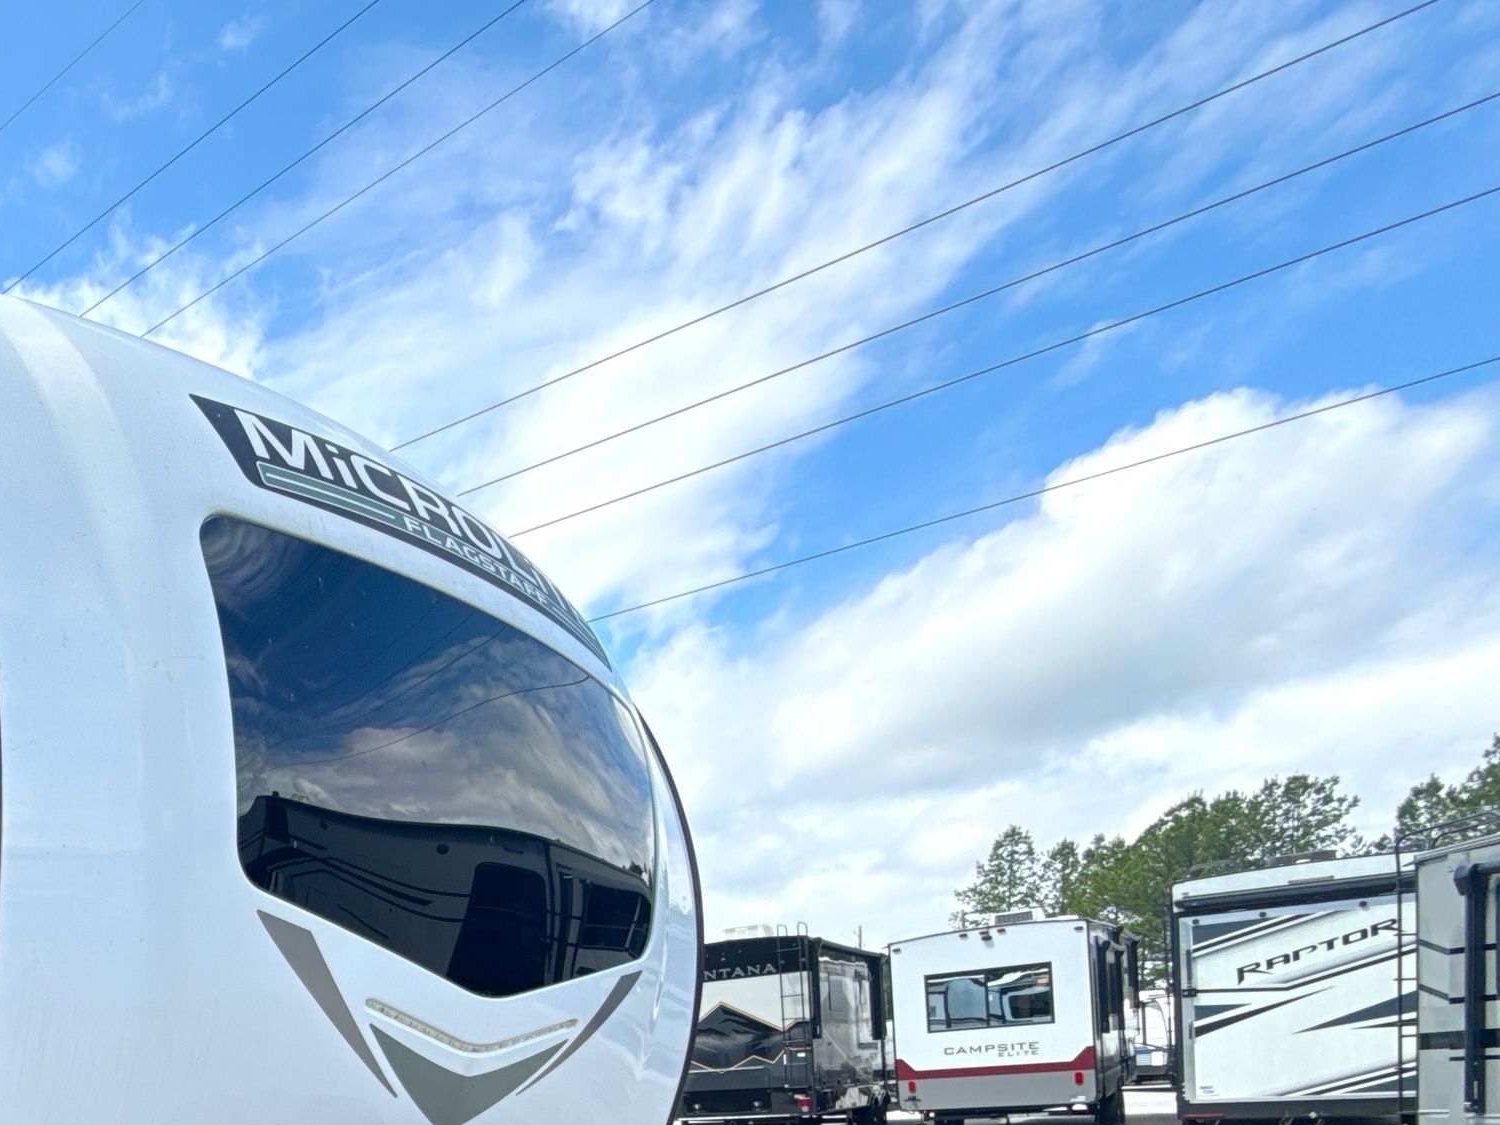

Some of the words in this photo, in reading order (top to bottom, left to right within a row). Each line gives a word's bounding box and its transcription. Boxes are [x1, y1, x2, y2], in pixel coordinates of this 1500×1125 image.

[403, 517, 549, 605] FLAGSTAFF
[1236, 917, 1405, 986] RAPTOR
[703, 962, 778, 981] NTANA
[943, 1041, 1040, 1056] CAMPSITE
[997, 1049, 1040, 1058] ELITE
